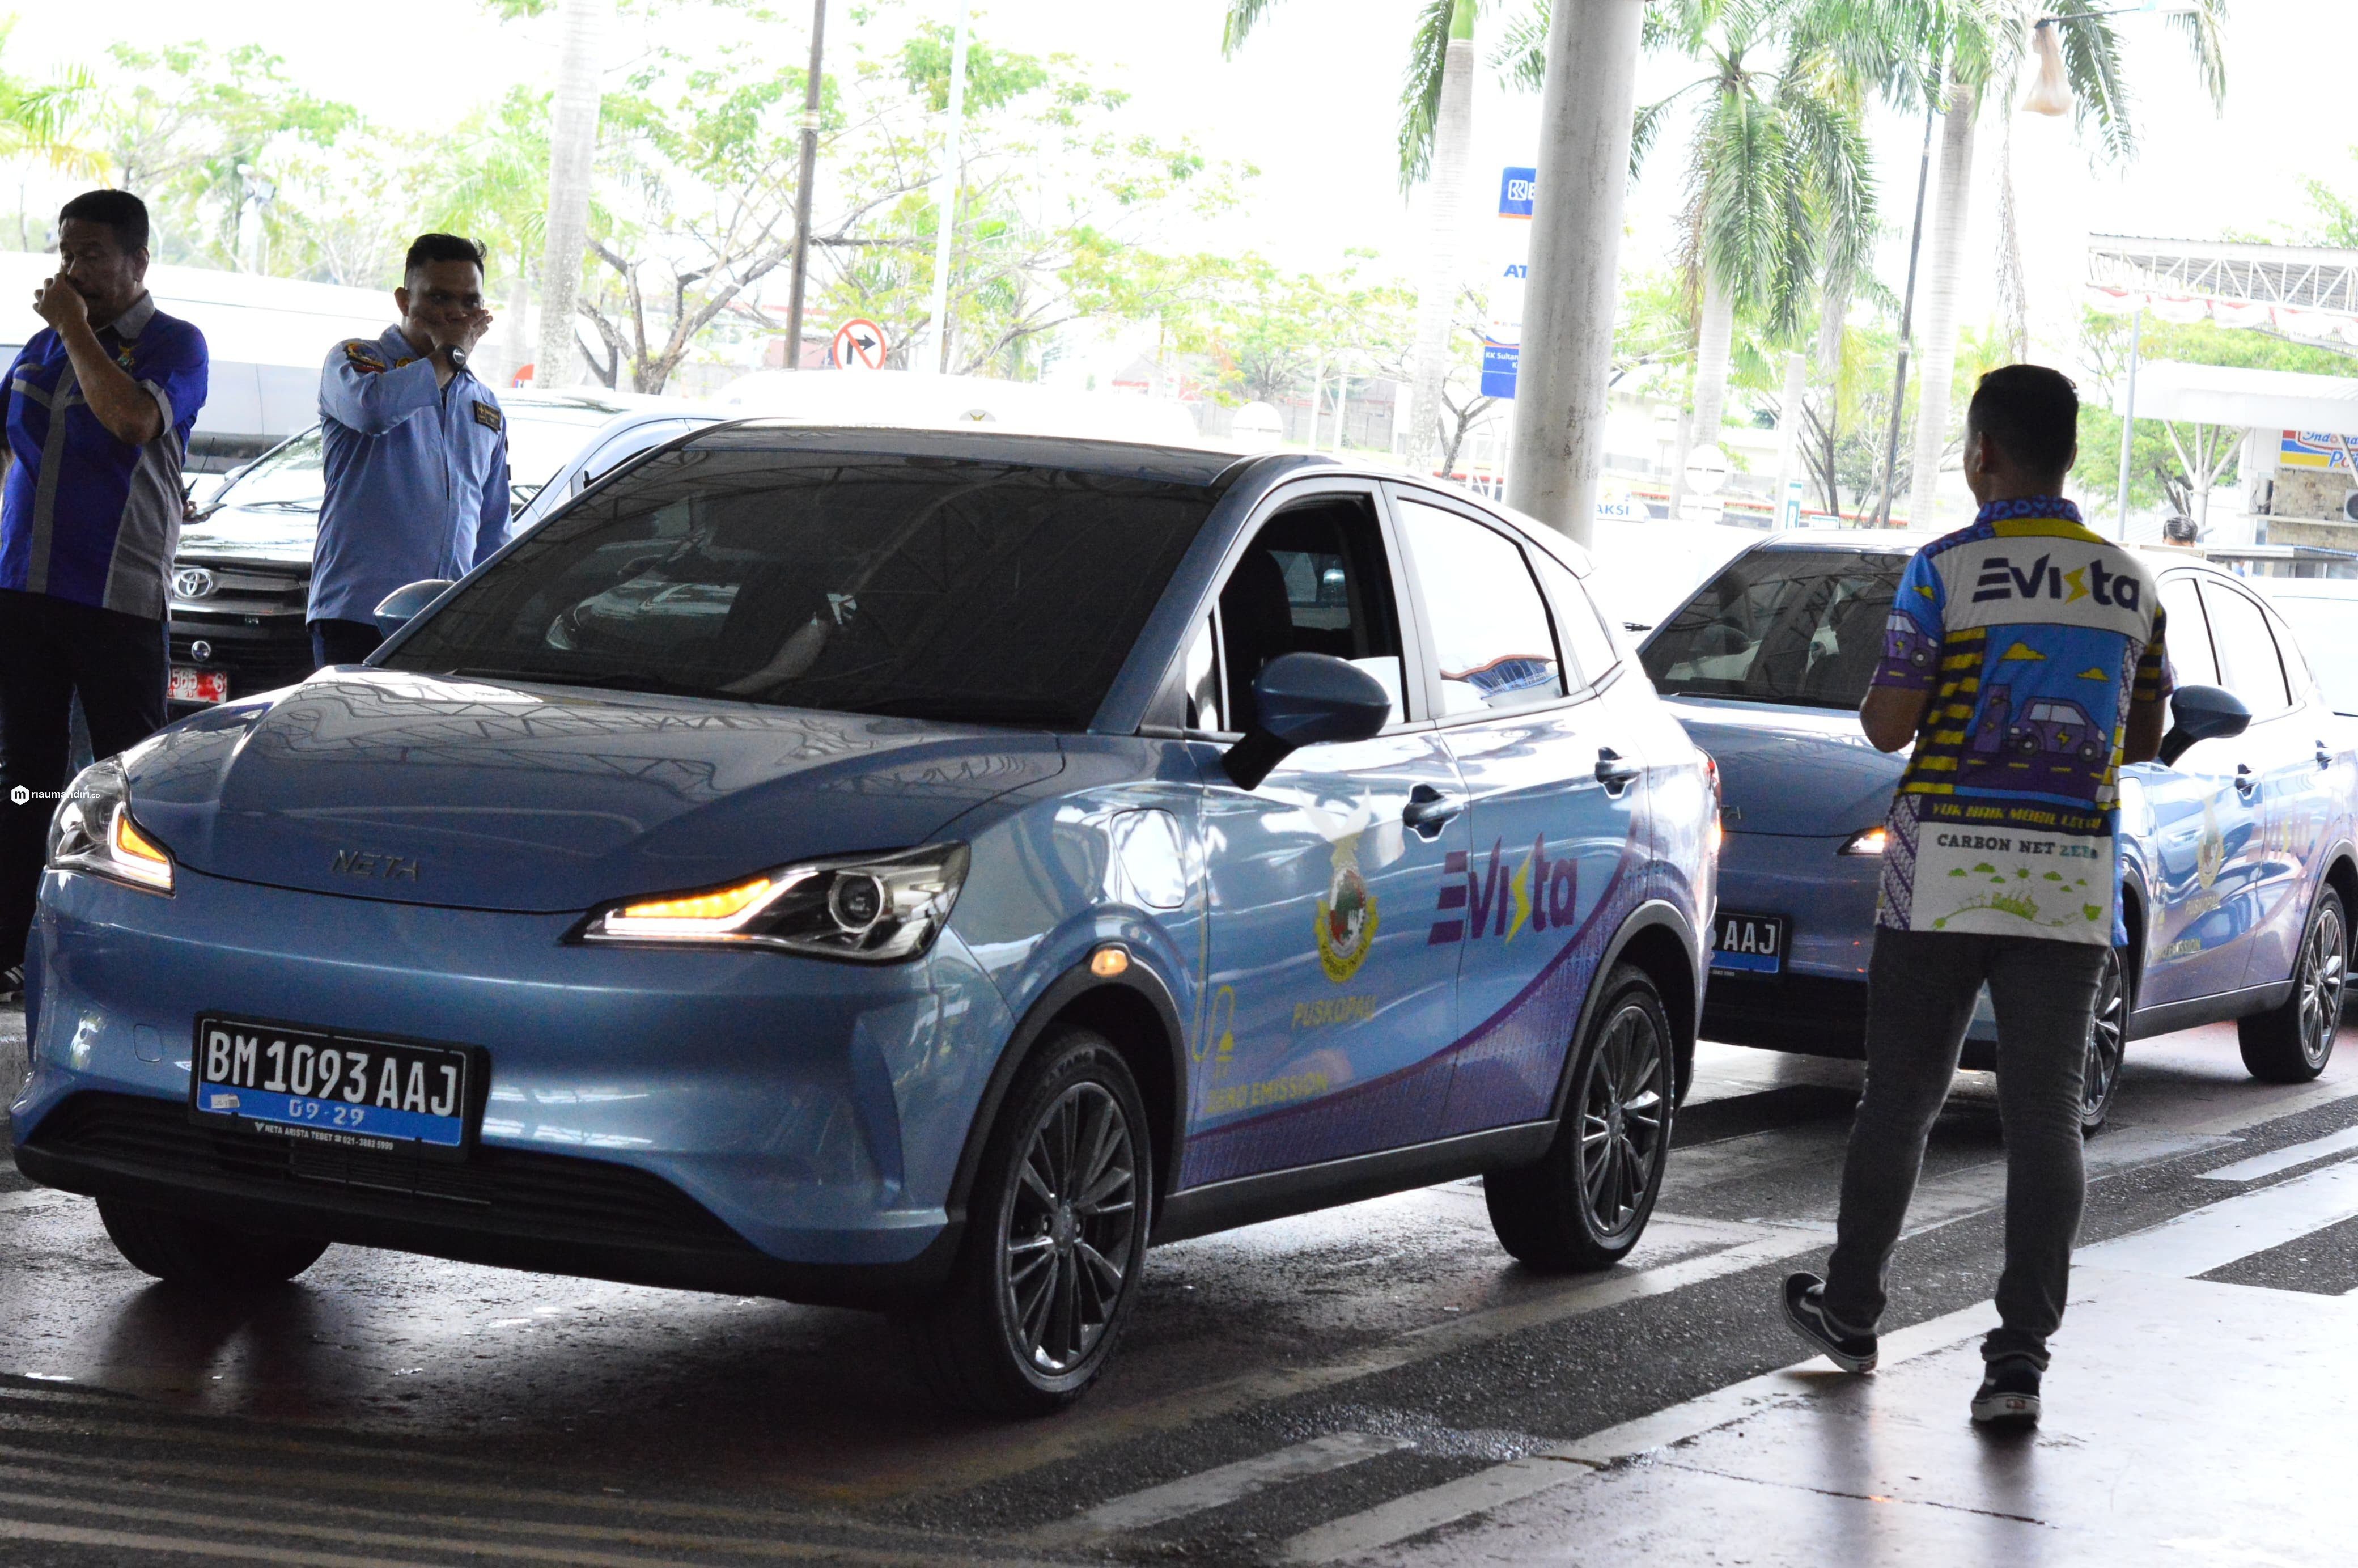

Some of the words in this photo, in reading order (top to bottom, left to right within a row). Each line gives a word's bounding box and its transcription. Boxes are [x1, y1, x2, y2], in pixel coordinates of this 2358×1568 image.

[1937, 834, 2011, 851] CARBON
[2019, 840, 2055, 854] NET
[1723, 921, 1776, 954] AAJ
[207, 1031, 259, 1087] BM
[264, 1041, 368, 1103] 1093
[376, 1057, 457, 1117] AAJ
[1251, 1071, 1328, 1106] EMISSION
